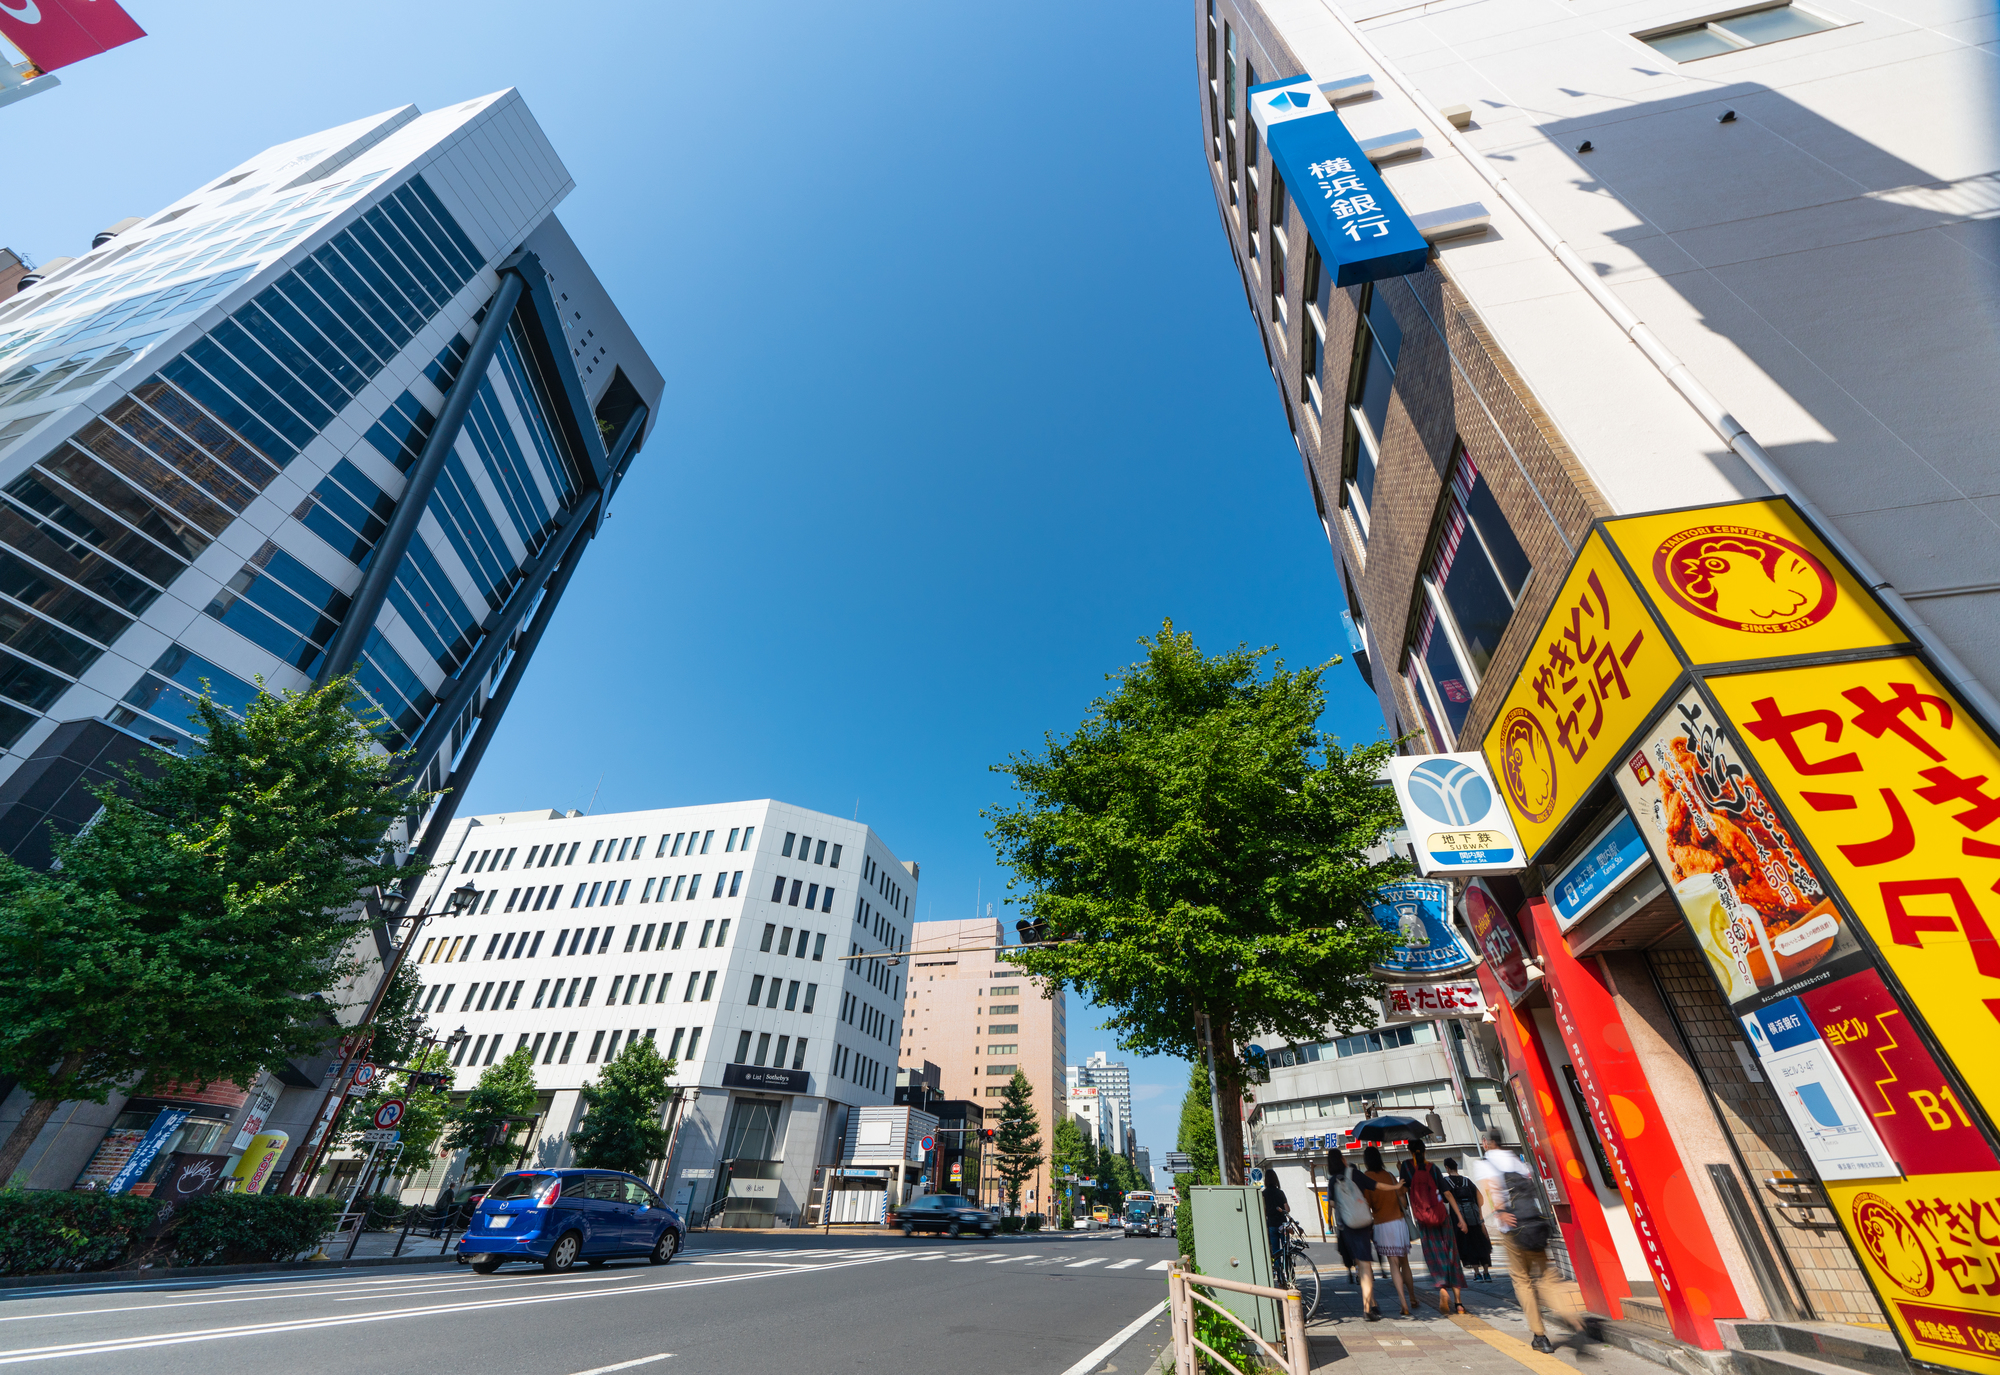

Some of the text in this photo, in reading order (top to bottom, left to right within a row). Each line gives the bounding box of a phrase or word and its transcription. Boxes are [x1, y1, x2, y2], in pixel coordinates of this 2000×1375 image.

[1308, 157, 1390, 242] 横浜銀行
[1663, 526, 1765, 549] YAKITORI CENTER
[1532, 567, 1610, 714] やきとり
[1740, 617, 1814, 634] SINCE 2012
[1555, 629, 1644, 765] センター
[1501, 708, 1525, 749] YAKITORI CENTER
[1841, 682, 2000, 897] やき
[1536, 797, 1555, 823] SINCE 2012
[1442, 832, 1493, 845] 地下鉄
[1459, 851, 1486, 859] 関内駅
[1575, 863, 1597, 889] 地下鉄
[1742, 696, 2000, 1023] センタ
[1580, 882, 1594, 897] Subway
[1602, 862, 1616, 876] Kannai
[1485, 925, 1512, 968] ガスト
[1767, 1014, 1801, 1035] 横浜銀行
[1824, 1018, 1868, 1046] 当ビル
[1908, 1085, 1972, 1131] B1
[365, 1132, 393, 1140] ここまで
[1293, 1133, 1338, 1151] 紳士服
[1521, 1098, 1547, 1177] ガスト
[1552, 987, 1574, 1035] CAFÉ
[1572, 1042, 1633, 1191] RESTAURANT
[1633, 1201, 1671, 1292] GUSTO
[246, 1151, 276, 1193] 4980
[1869, 1192, 1892, 1210] CENTER
[1936, 1246, 2000, 1297] セン
[1901, 1284, 1931, 1297] SINCE 2012
